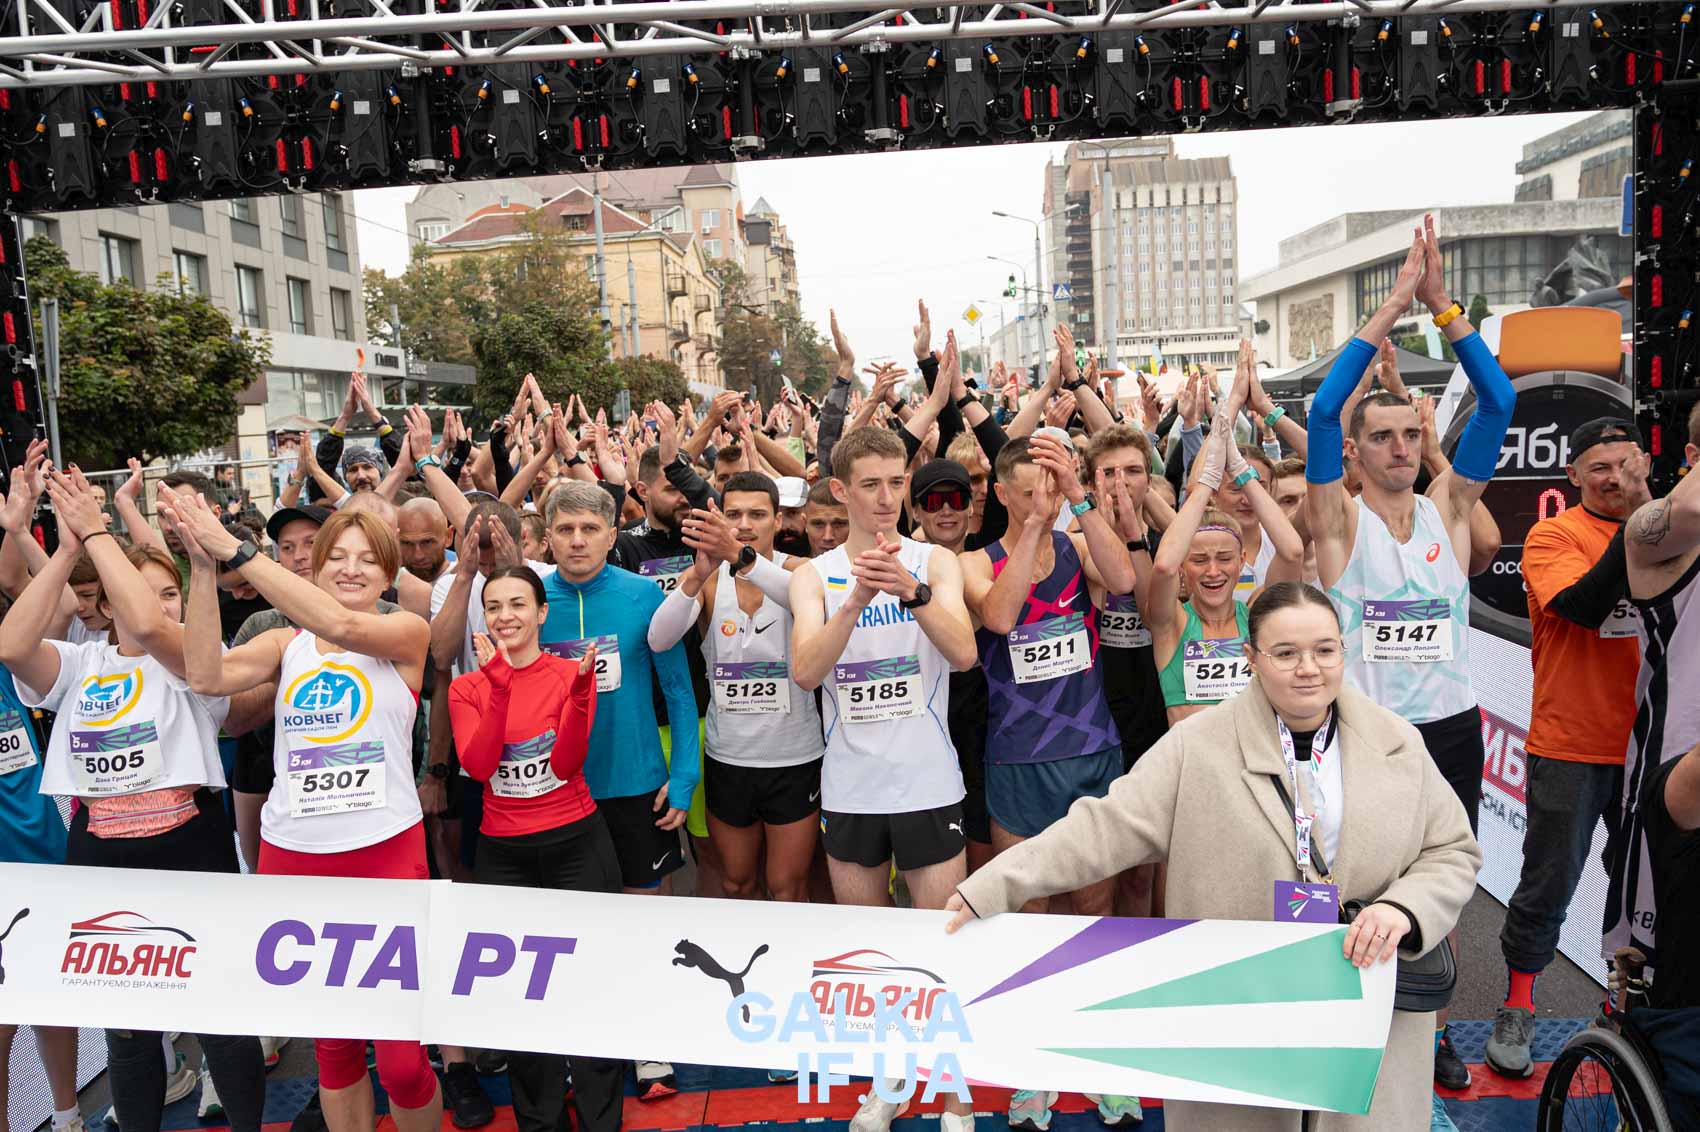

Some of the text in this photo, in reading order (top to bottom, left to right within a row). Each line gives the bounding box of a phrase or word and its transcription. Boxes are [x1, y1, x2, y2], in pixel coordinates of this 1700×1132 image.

[856, 602, 916, 628] RAIN
[1365, 606, 1375, 616] 5
[1010, 630, 1018, 641] 5
[1376, 624, 1438, 642] 5147
[1024, 637, 1075, 663] 5211
[1186, 645, 1195, 657] 5
[716, 667, 724, 677] 5
[837, 668, 846, 679] 5
[1196, 662, 1252, 680] 5214
[726, 682, 777, 698] 5123
[850, 681, 908, 702] 5185
[284, 713, 343, 727] КОВЧЕГ
[72, 736, 80, 748] 5
[85, 750, 145, 774] 5005
[290, 754, 301, 767] 5
[498, 758, 550, 780] 5107
[302, 769, 370, 793] 5307
[60, 941, 197, 978] АЛЬЯНС
[62, 977, 187, 990] ГАРАНТУЄМО ВРАЖЕННЯ
